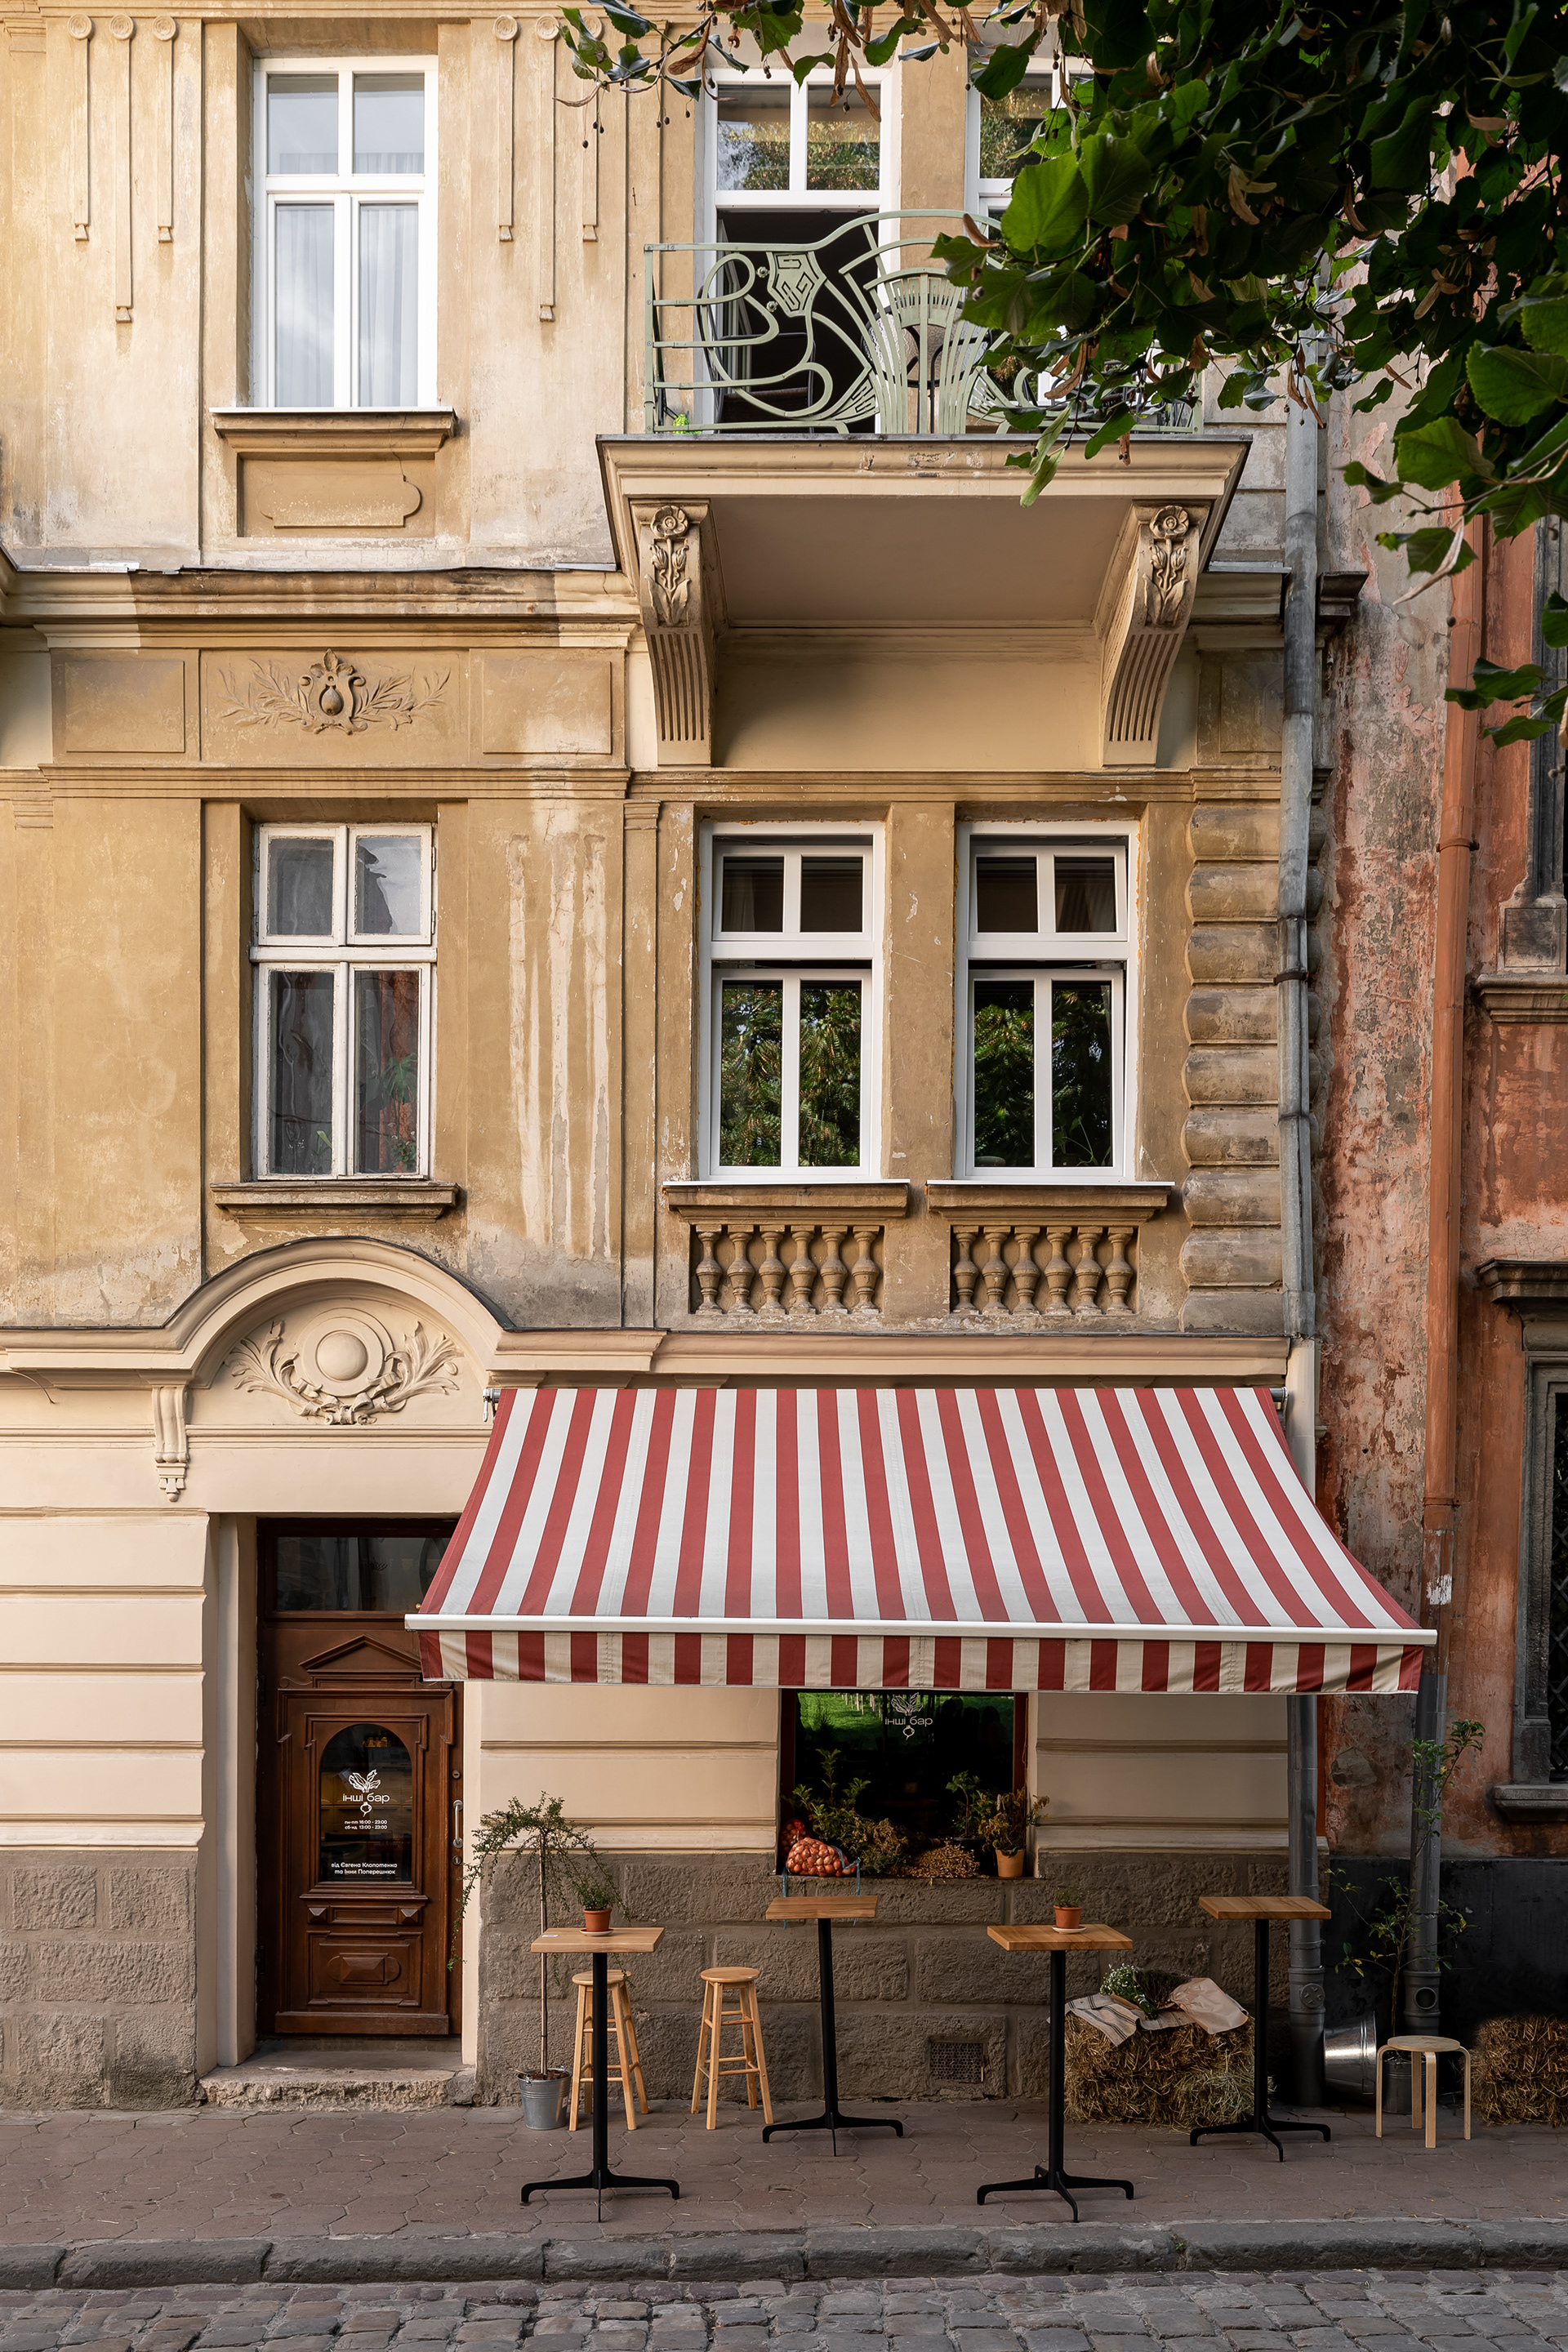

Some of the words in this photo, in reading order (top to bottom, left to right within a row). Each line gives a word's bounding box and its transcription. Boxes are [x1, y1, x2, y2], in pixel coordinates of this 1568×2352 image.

[885, 1717, 906, 1725] інші
[910, 1716, 933, 1727] бар
[343, 1793, 363, 1802] інші
[367, 1793, 390, 1804] бар
